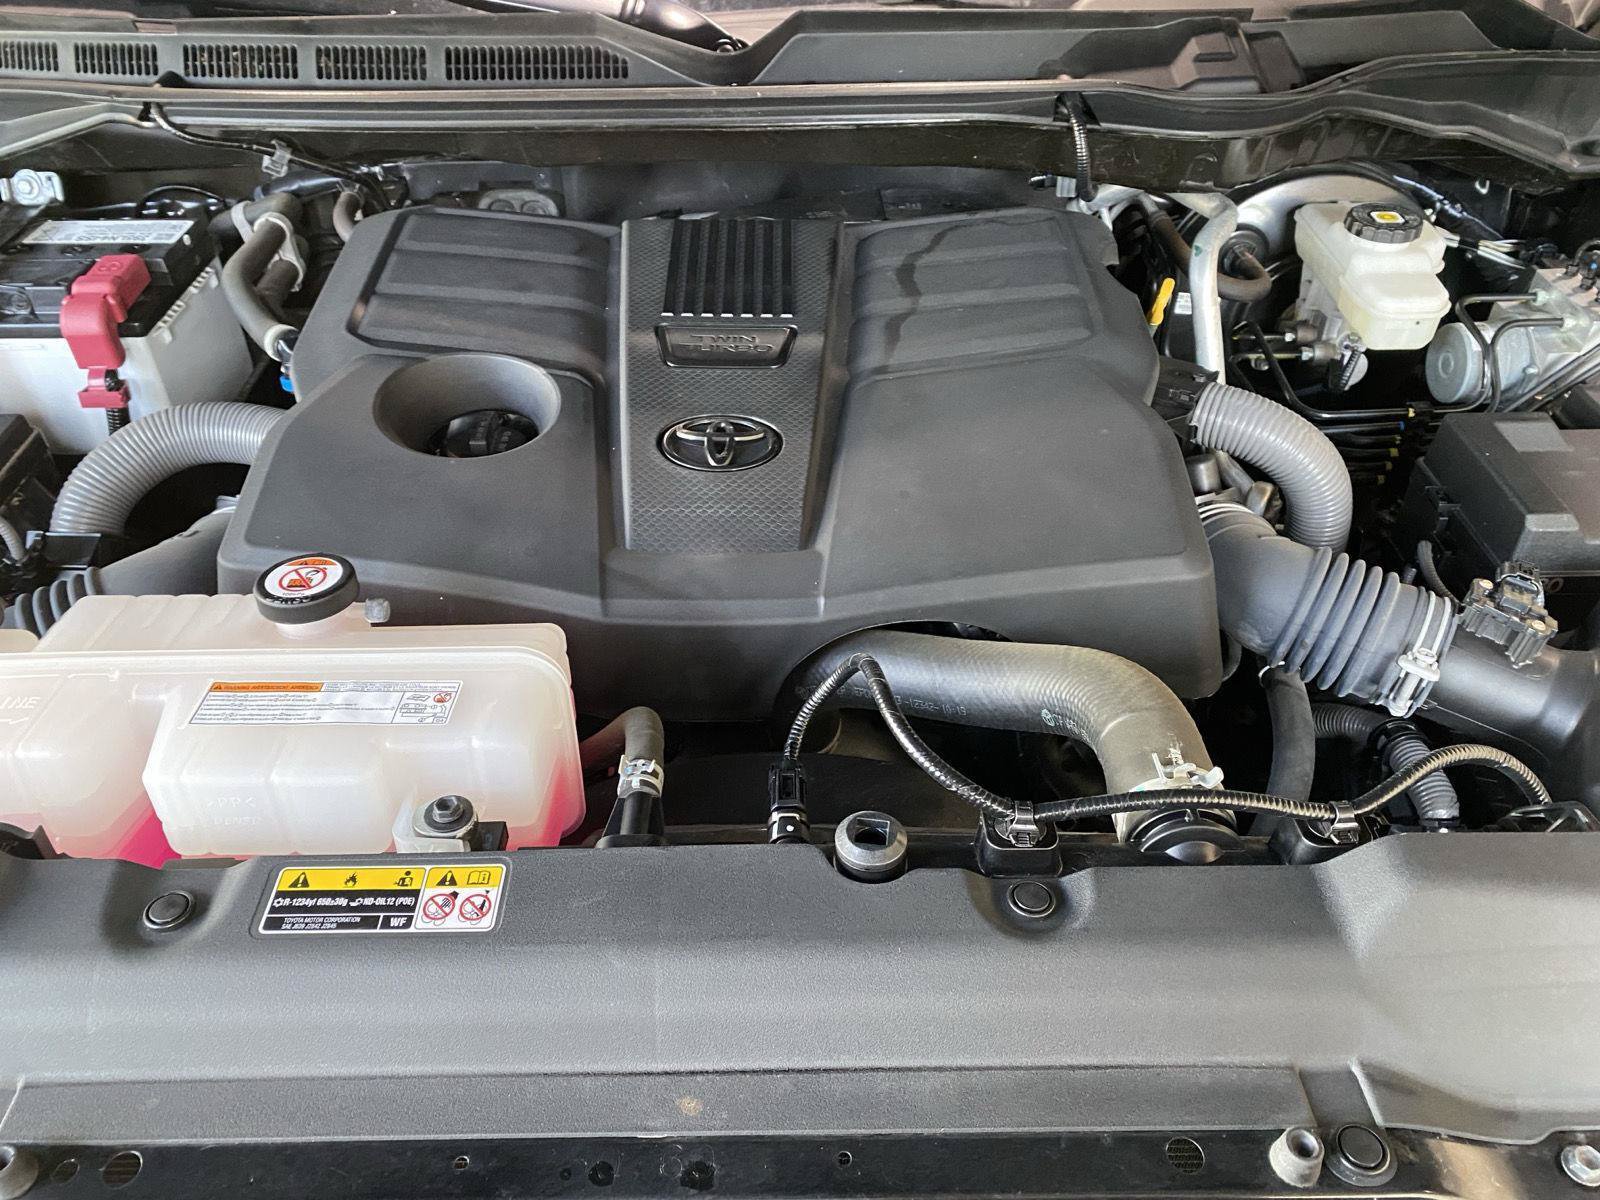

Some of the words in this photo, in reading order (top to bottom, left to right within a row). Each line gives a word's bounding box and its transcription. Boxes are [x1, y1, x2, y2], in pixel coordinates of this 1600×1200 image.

[690, 334, 760, 344] TWIN
[679, 343, 776, 353] TURBO
[282, 898, 317, 908] R-1234yf
[395, 896, 416, 907] (POE)
[390, 917, 408, 927] WF
